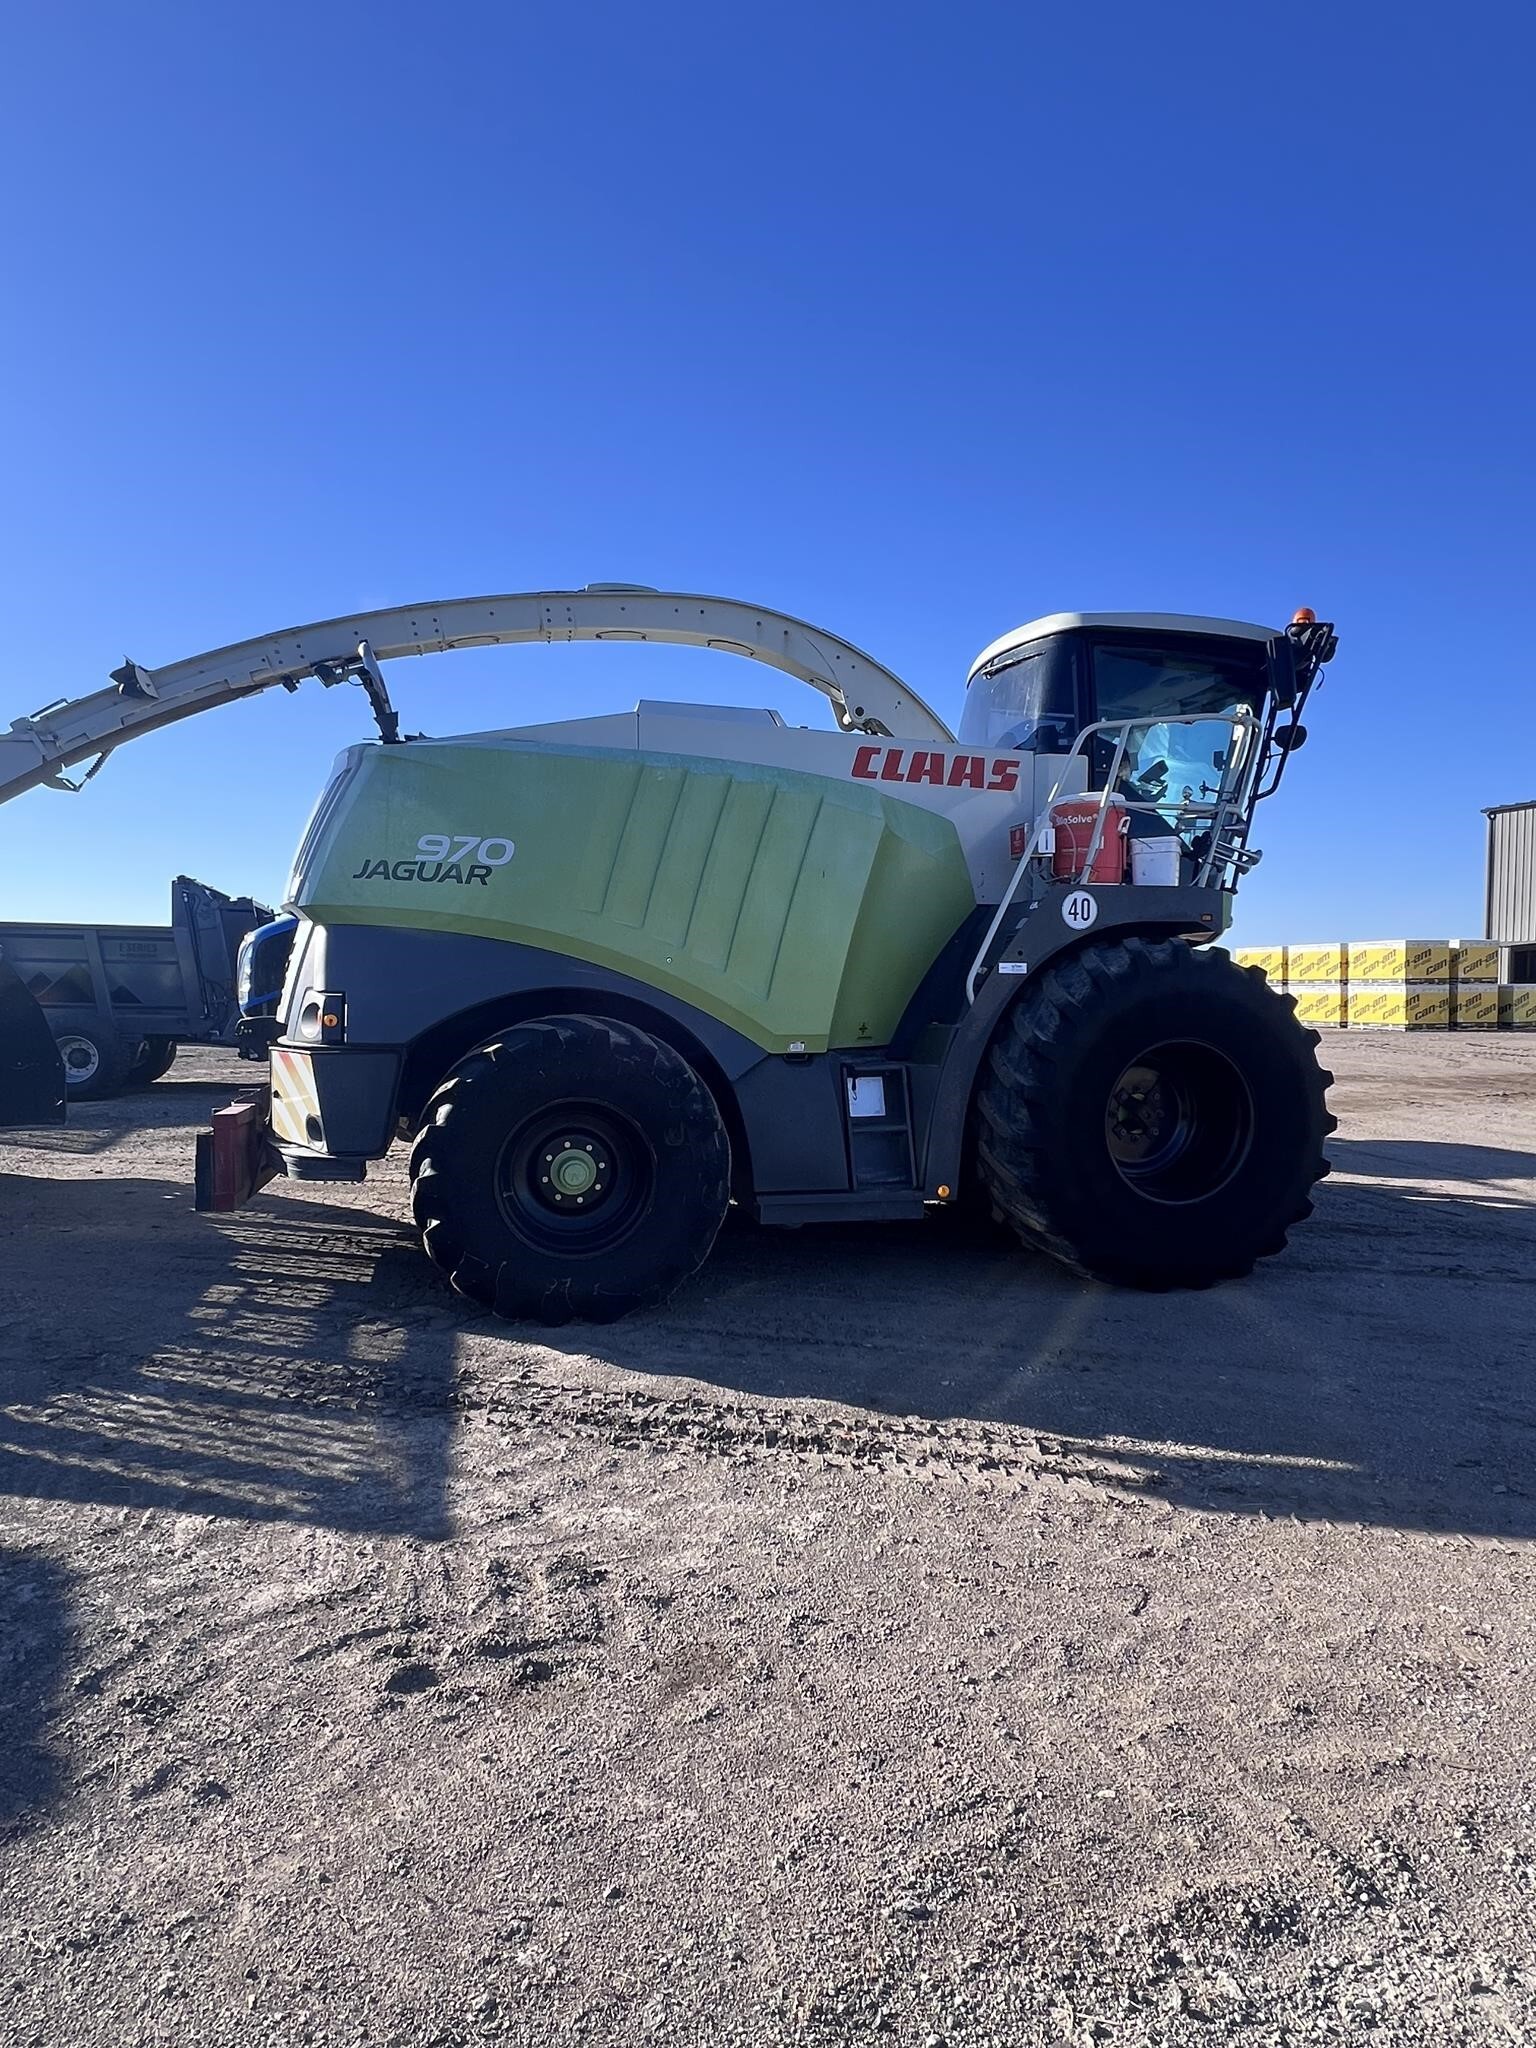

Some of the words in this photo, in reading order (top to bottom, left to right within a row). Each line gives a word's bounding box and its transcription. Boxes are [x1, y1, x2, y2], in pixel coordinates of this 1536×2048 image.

[851, 745, 1021, 792] CLAAS
[415, 834, 515, 866] 970
[352, 859, 493, 886] JAGUAR
[1068, 897, 1091, 922] 40
[1299, 951, 1330, 977] can-am
[1363, 948, 1397, 976] can-am
[1299, 994, 1329, 1017] can-am
[1354, 993, 1387, 1019] can-am
